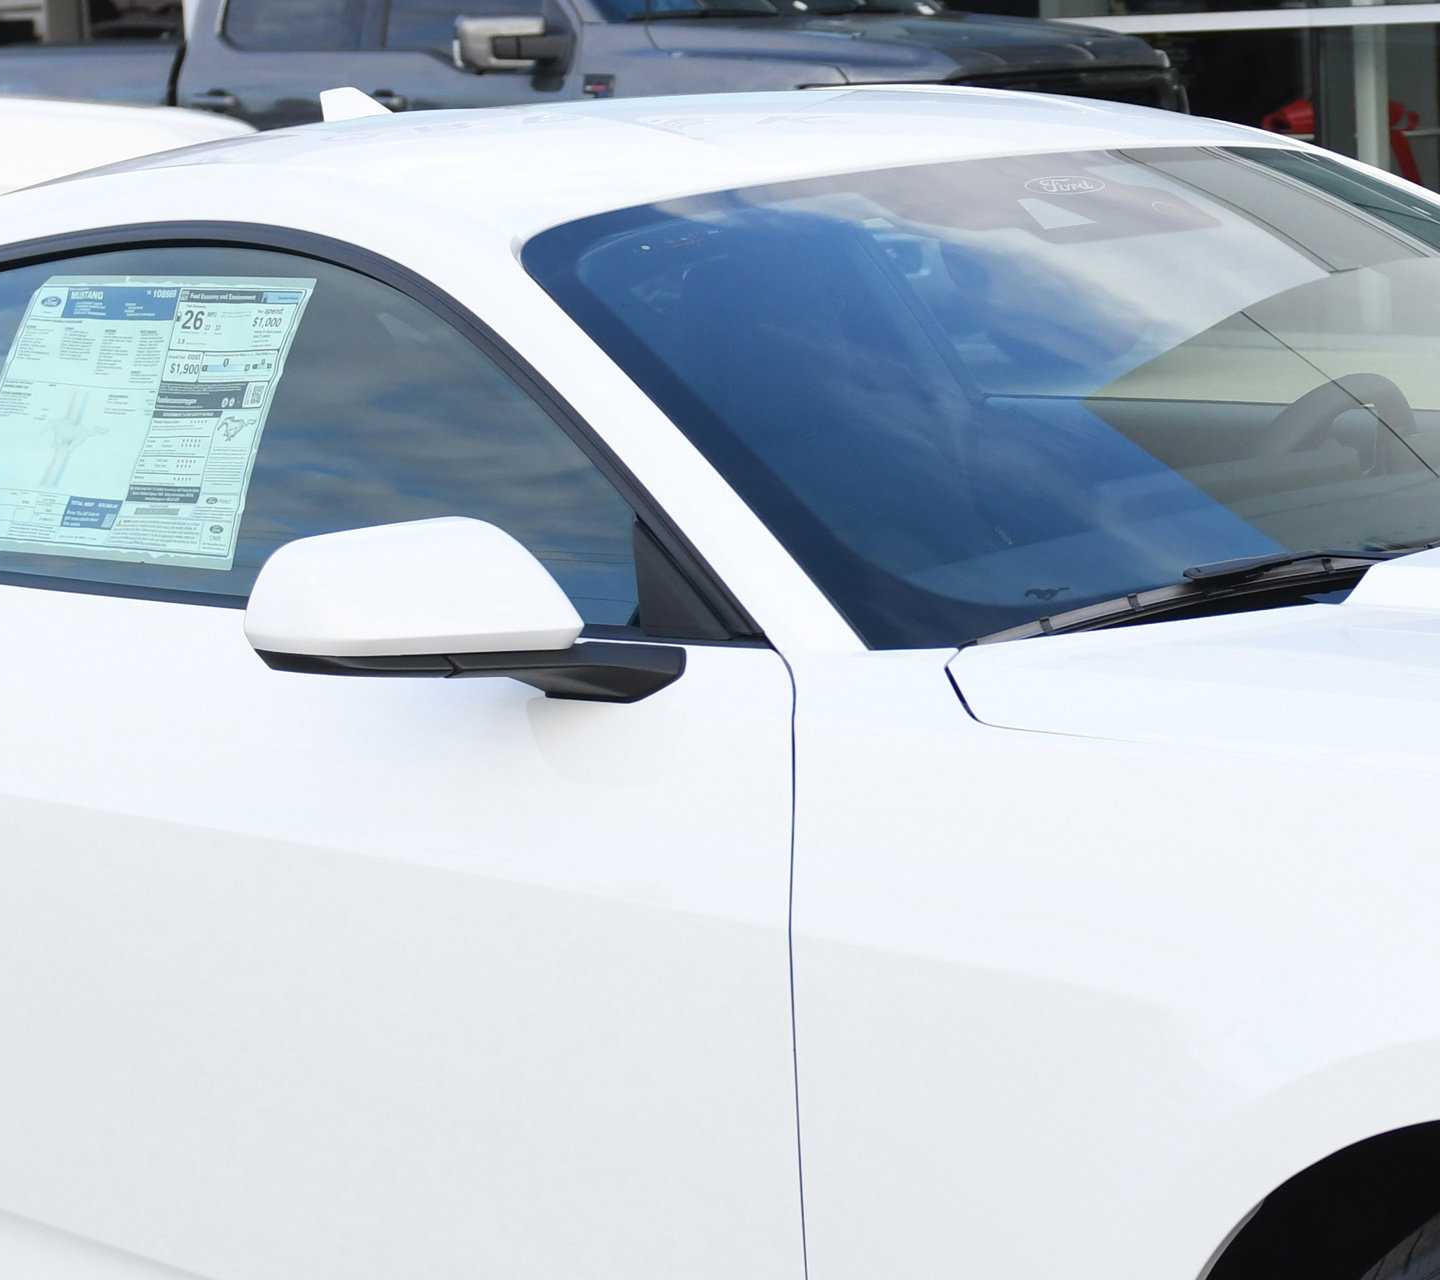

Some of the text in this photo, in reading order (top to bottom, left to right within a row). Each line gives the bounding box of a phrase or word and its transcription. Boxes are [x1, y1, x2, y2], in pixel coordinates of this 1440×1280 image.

[1040, 178, 1094, 193] Ford
[181, 309, 205, 331] 26
[252, 316, 283, 328] $1,000
[170, 363, 200, 376] $1,900
